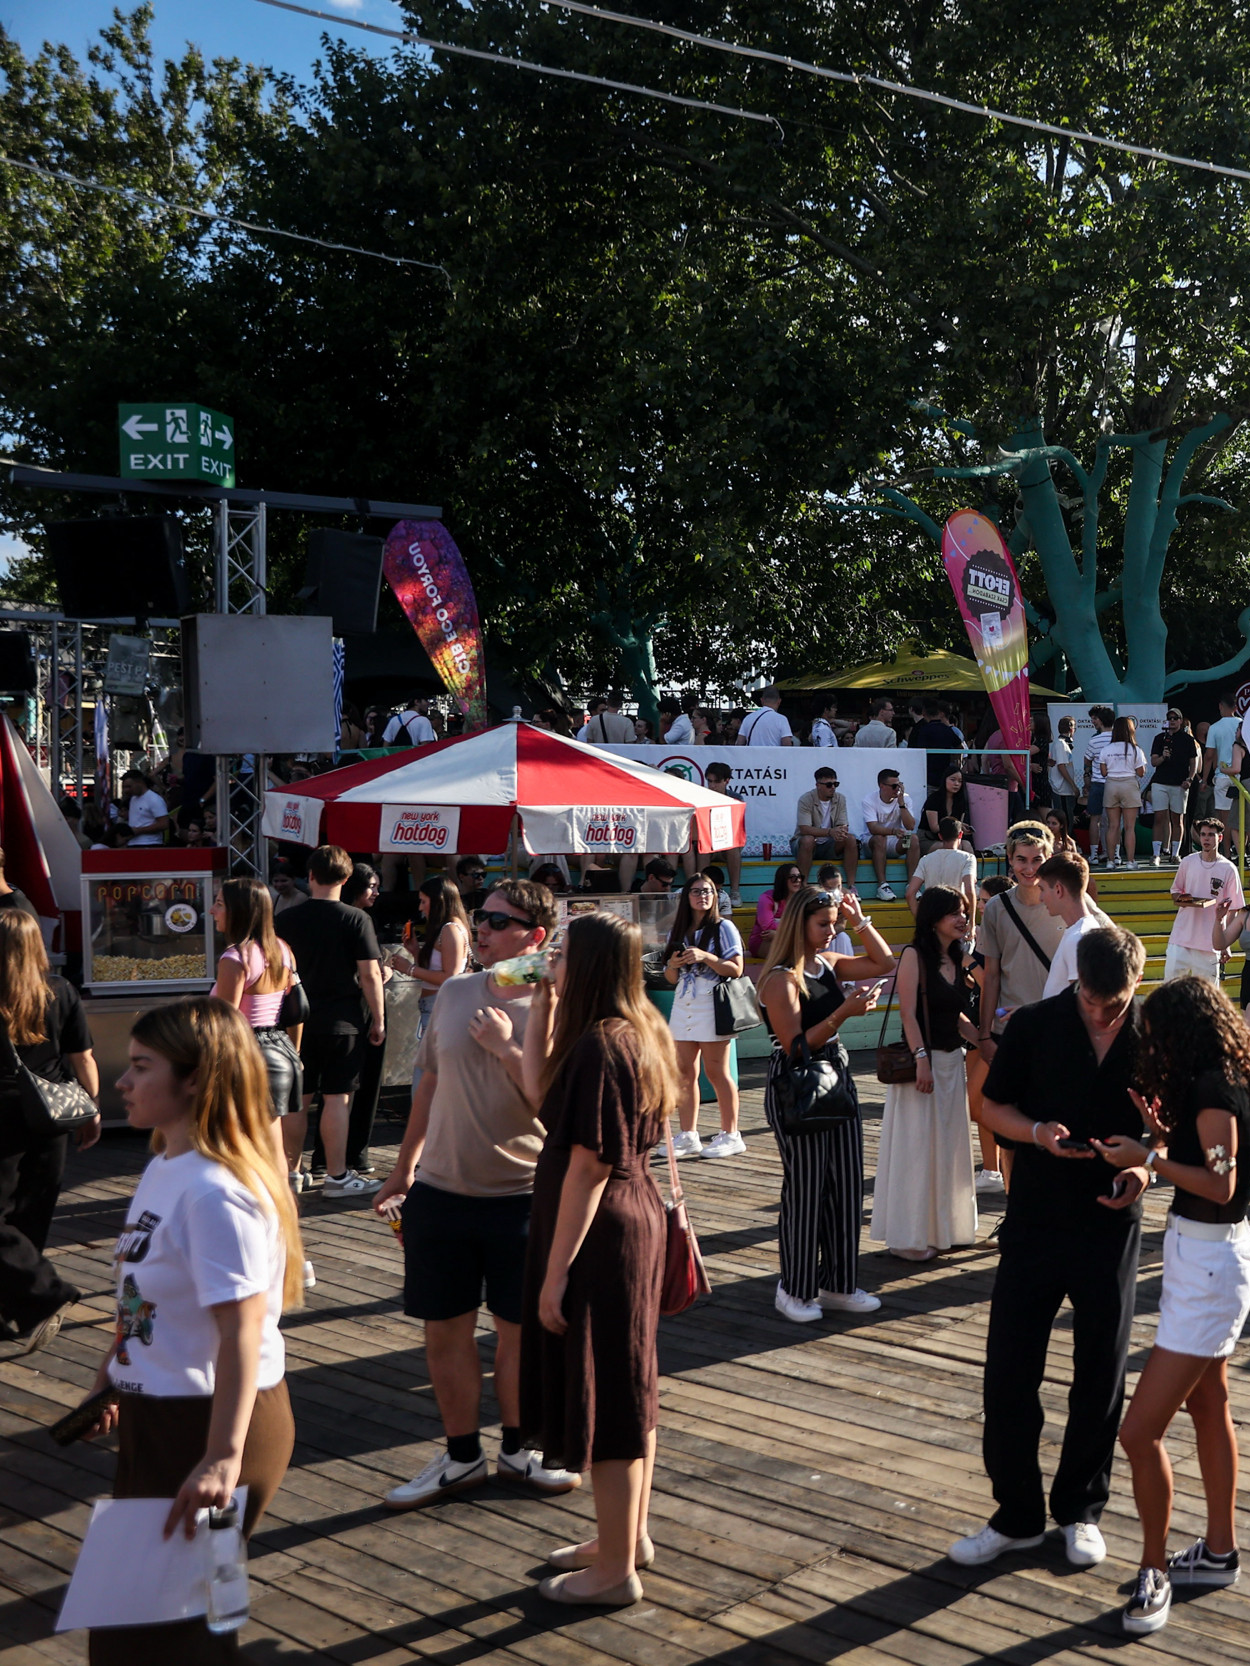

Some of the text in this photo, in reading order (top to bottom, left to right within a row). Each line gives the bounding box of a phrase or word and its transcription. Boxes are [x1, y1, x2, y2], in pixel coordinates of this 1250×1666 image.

[130, 453, 190, 470] EXIT
[201, 455, 232, 479] EXIT
[107, 662, 134, 674] PEST
[728, 765, 787, 780] TATÁSI
[728, 785, 777, 797] VATAL
[401, 811, 440, 823] new york
[393, 823, 448, 846] hotdog
[585, 823, 635, 844] hotdog
[97, 882, 196, 902] POPCORN
